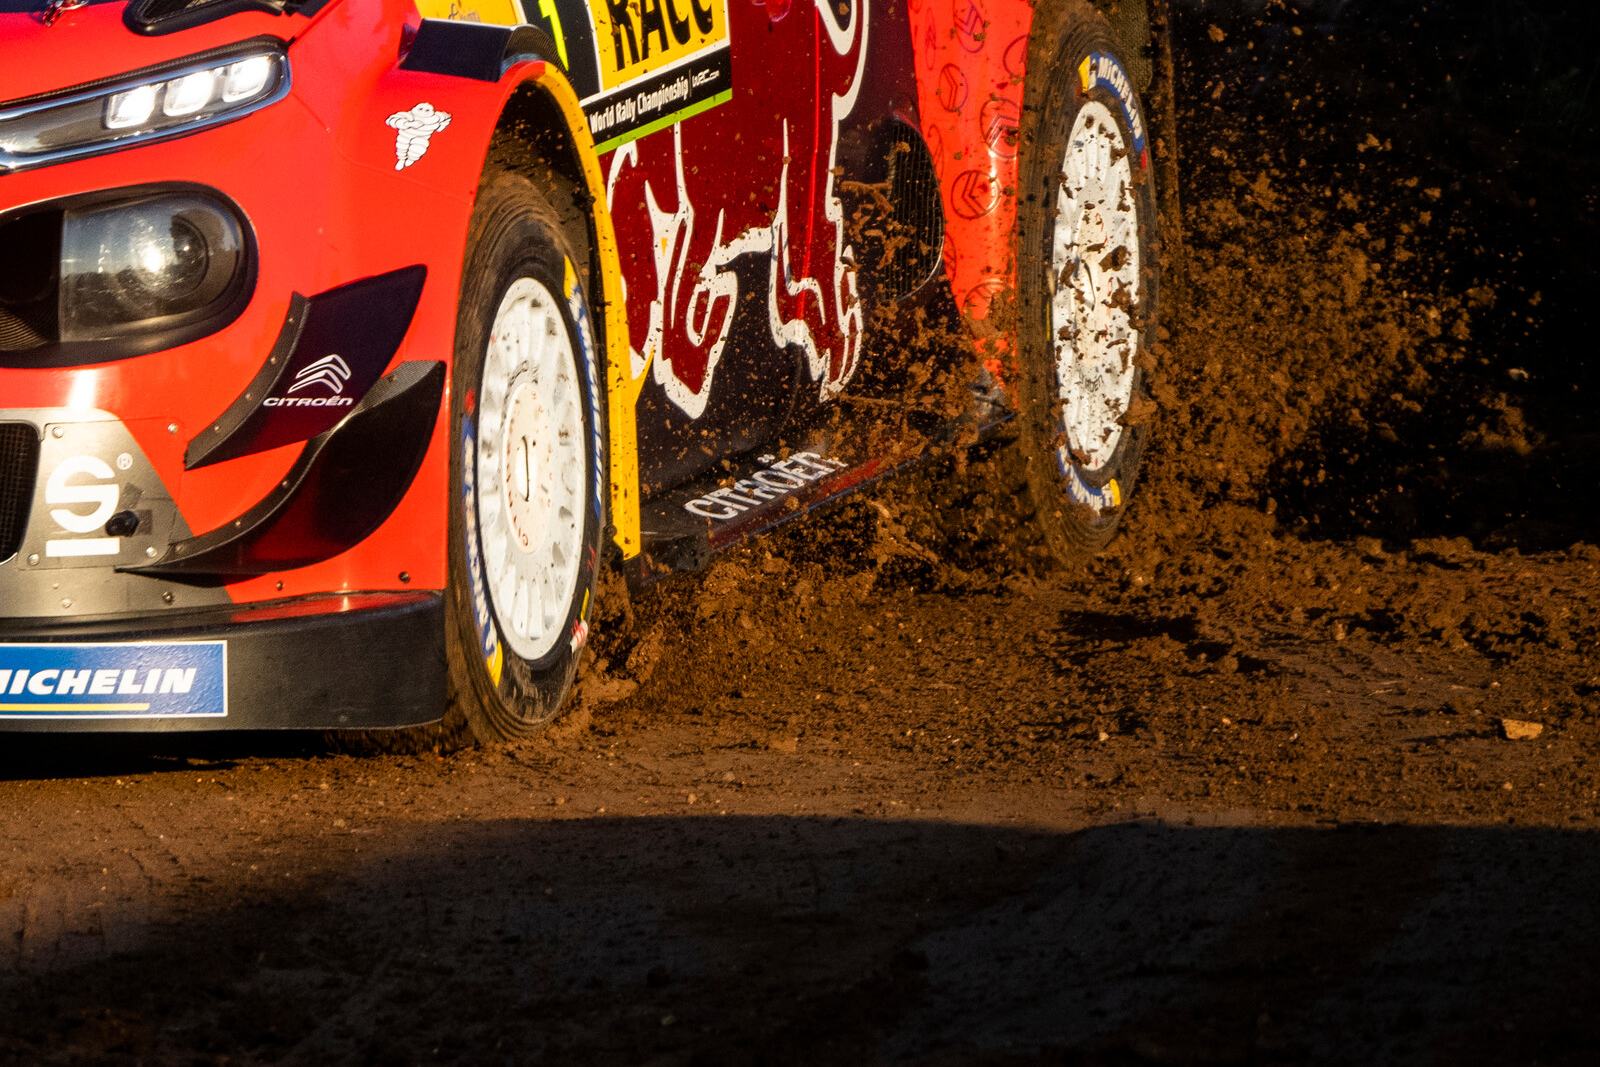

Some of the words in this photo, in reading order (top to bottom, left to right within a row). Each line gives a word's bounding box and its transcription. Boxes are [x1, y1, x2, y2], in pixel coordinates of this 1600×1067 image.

[589, 104, 615, 134] World
[615, 97, 636, 123] Rally
[637, 76, 689, 115] Championship
[263, 395, 354, 408] CITROËN
